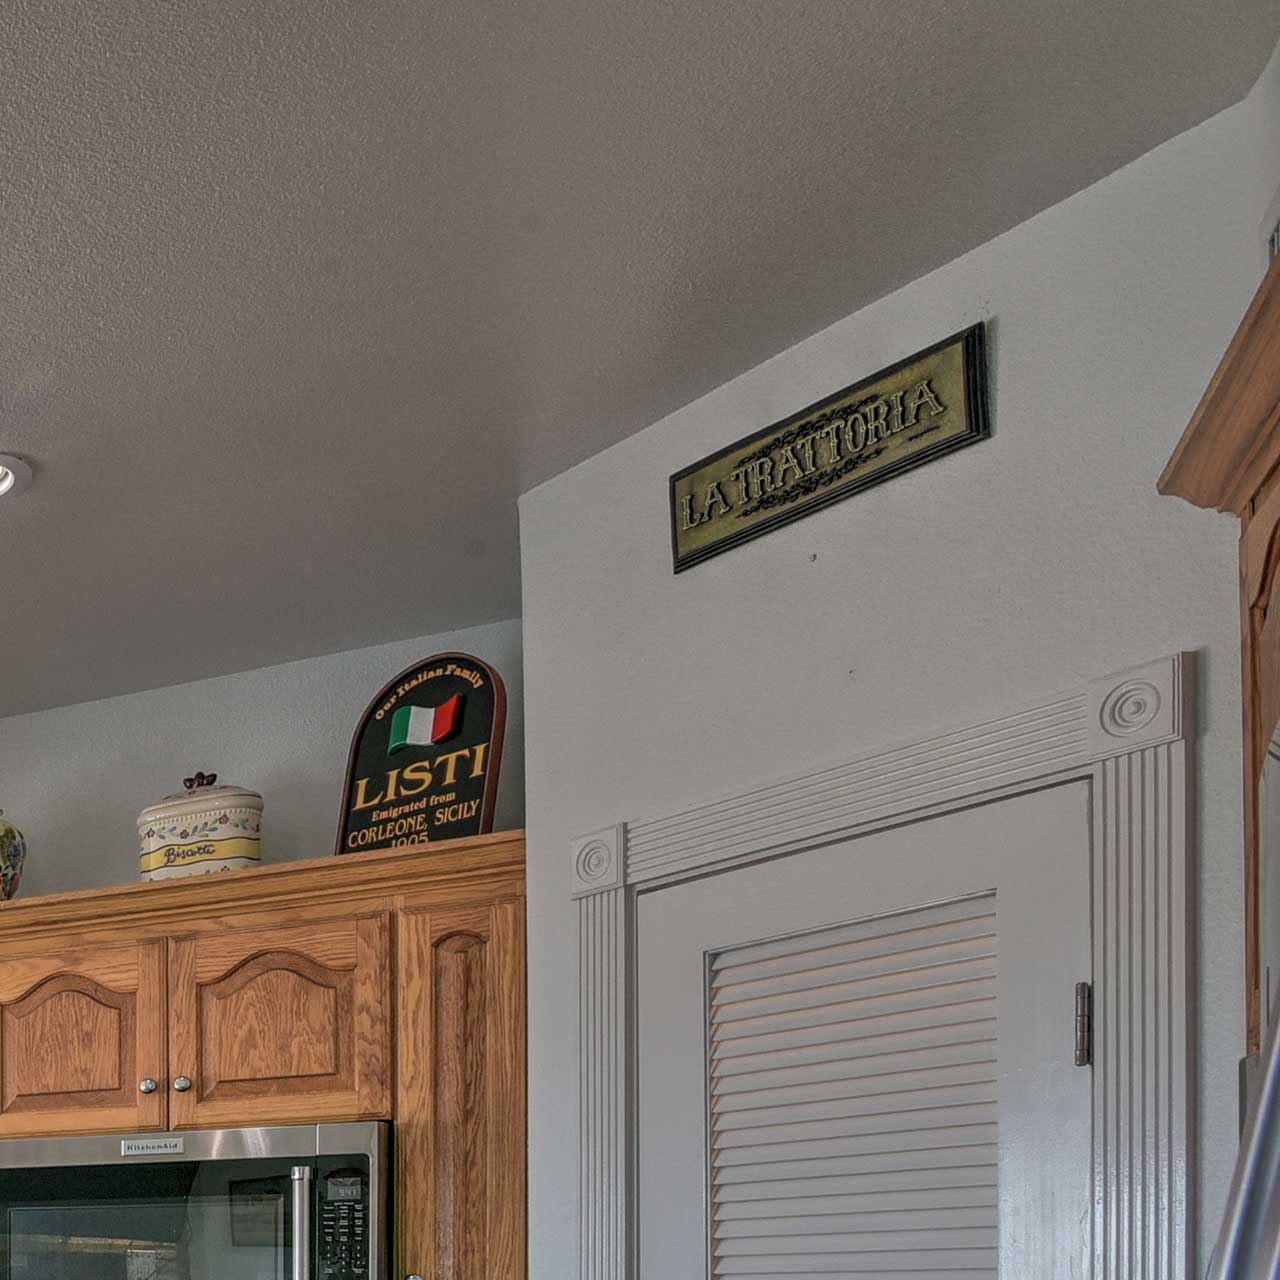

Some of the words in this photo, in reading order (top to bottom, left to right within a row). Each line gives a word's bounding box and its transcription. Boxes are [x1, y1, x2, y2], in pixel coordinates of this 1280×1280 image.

[681, 479, 731, 531] LA
[730, 378, 946, 506] TRATTORIA
[375, 692, 398, 721] Our
[397, 667, 443, 698] Italian
[444, 663, 485, 689] Family
[351, 742, 489, 812] LISTI
[347, 813, 429, 849] CORLEONE,
[434, 799, 481, 826] SICILY
[371, 798, 427, 822] Emigrated
[429, 791, 456, 807] from
